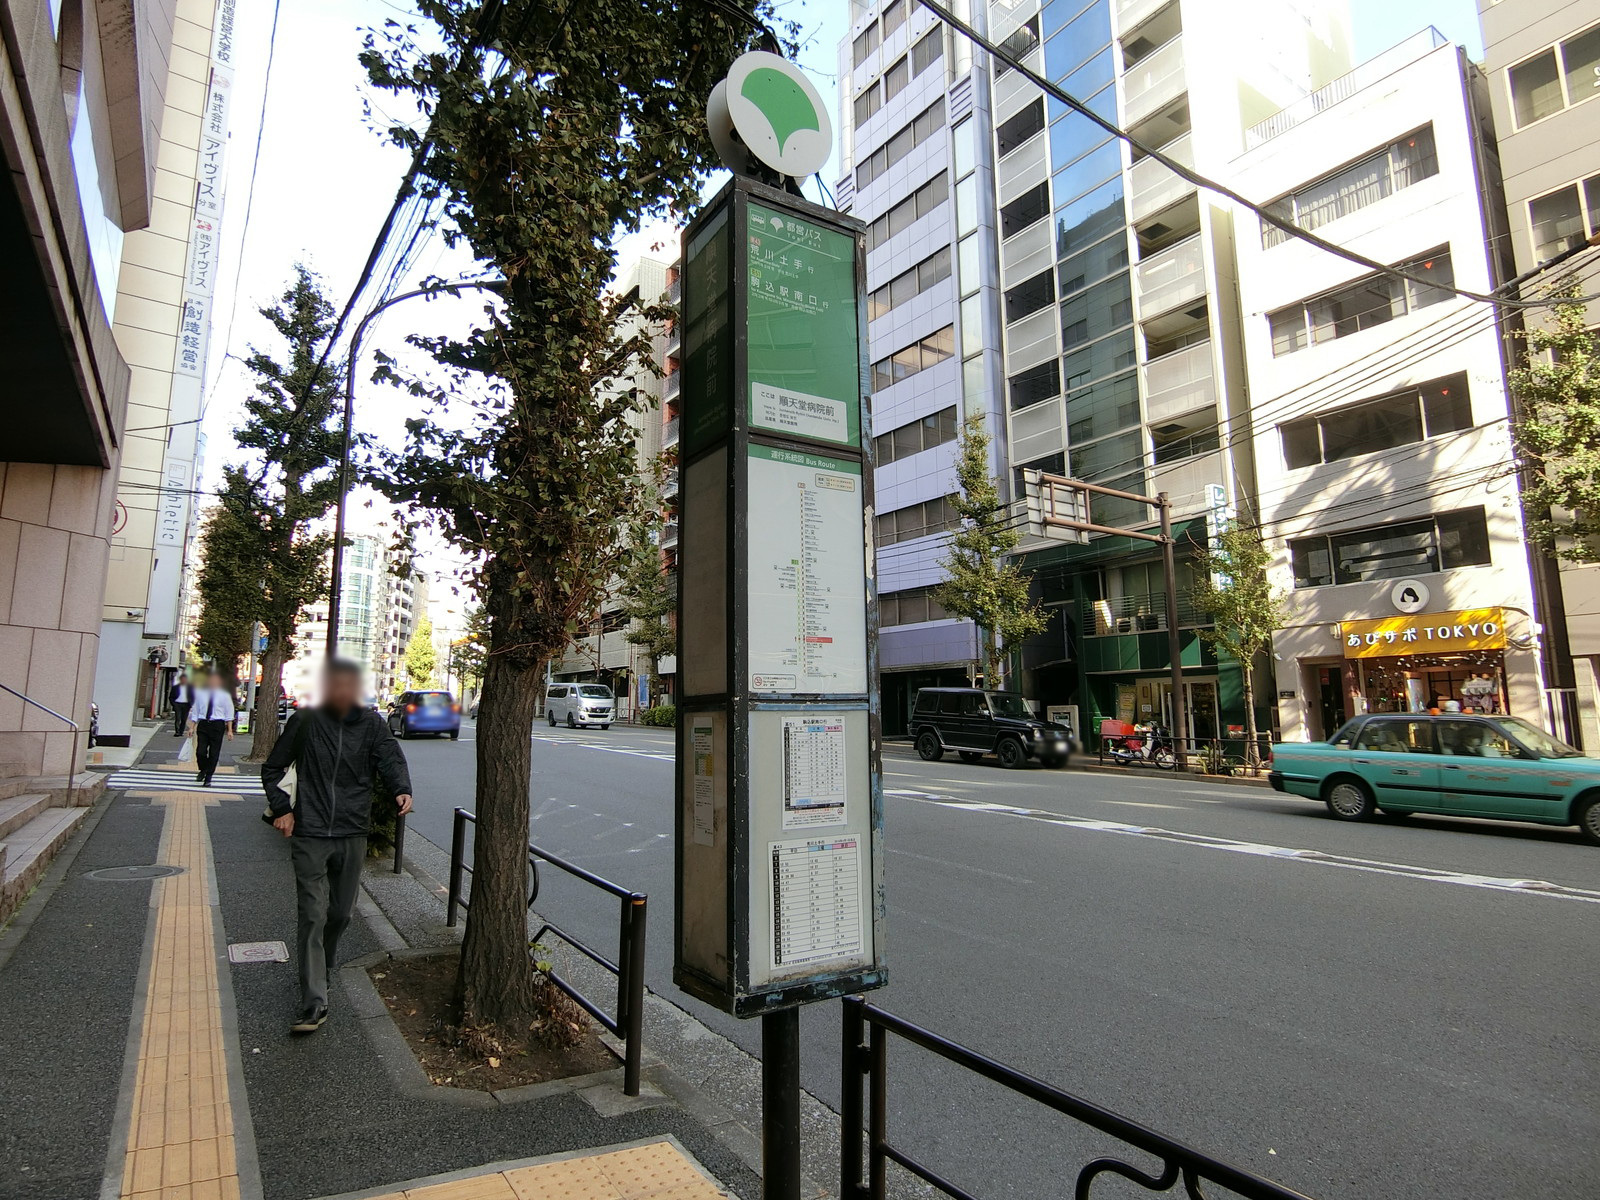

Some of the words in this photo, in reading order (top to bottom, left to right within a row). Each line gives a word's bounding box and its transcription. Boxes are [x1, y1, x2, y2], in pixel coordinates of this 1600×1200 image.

[210, 92, 225, 134] 株式会社
[201, 139, 220, 198] アイヴィス
[787, 222, 822, 242] 都営バス
[181, 305, 203, 363] 創造経営
[760, 391, 775, 399] ここは
[779, 395, 835, 417] 順天堂病院前
[806, 457, 817, 465] Bus
[817, 460, 836, 469] Route
[1348, 628, 1418, 647] あびサポ
[1424, 622, 1497, 640] TOKYO
